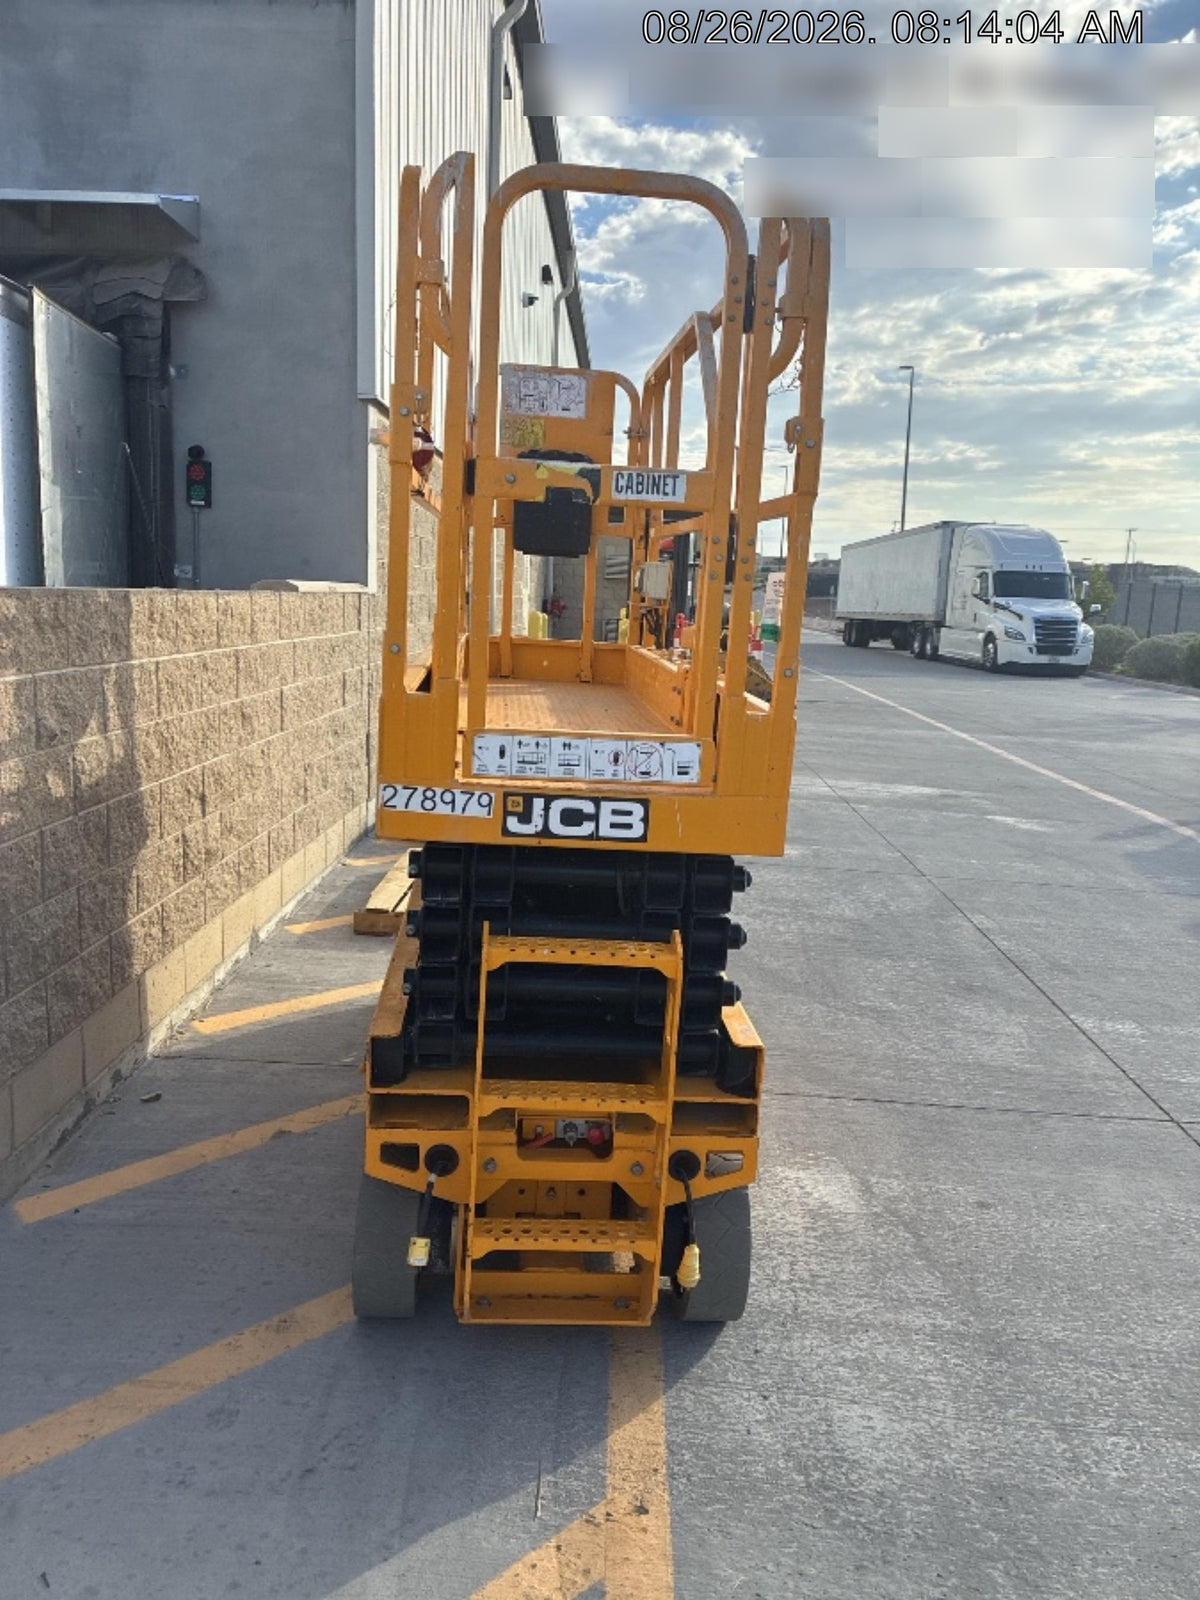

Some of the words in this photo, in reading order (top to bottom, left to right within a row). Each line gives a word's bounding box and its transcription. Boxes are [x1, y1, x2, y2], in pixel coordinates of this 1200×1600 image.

[614, 471, 680, 497] CABINET
[381, 785, 494, 817] 278979
[505, 797, 645, 839] JCB
